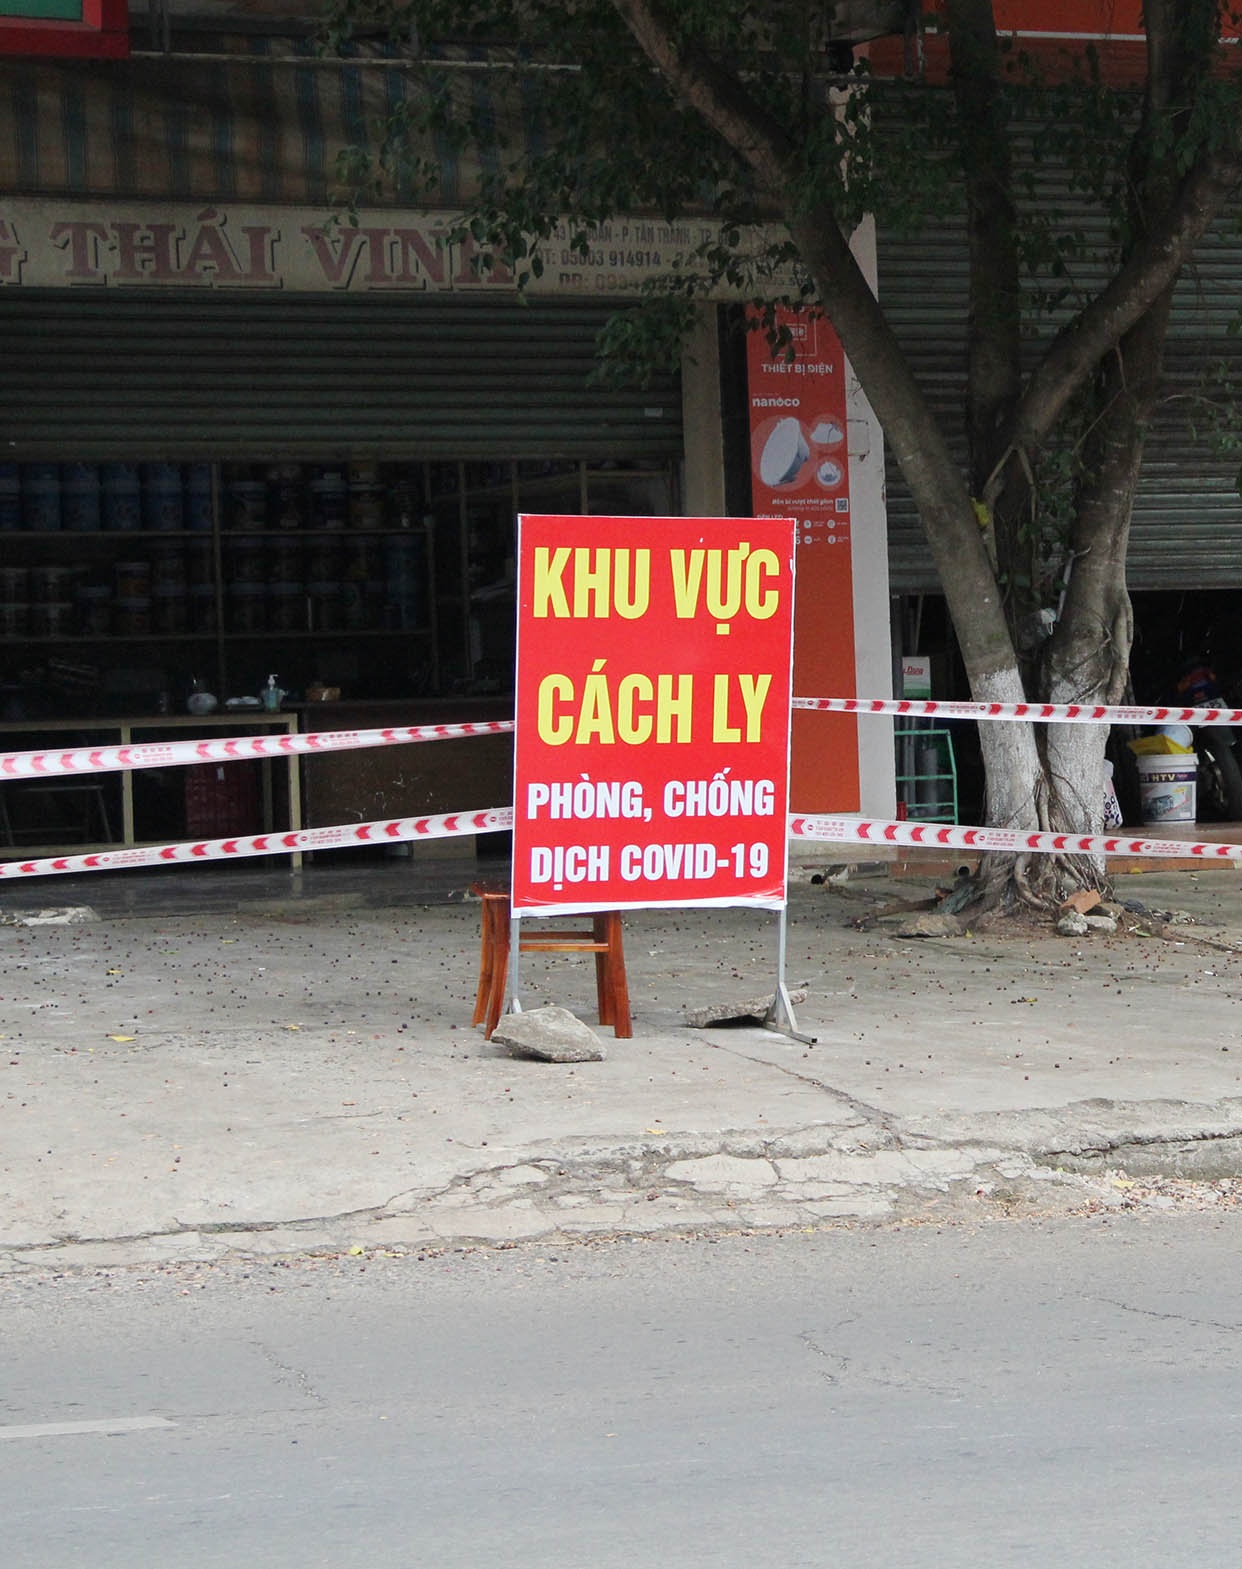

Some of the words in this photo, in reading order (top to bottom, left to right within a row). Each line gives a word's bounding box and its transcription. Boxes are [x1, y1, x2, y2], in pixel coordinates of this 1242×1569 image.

[49, 207, 281, 286] THÁI
[609, 250, 661, 267] 914914
[752, 396, 801, 408] nanoco
[533, 546, 651, 620] KHU
[669, 542, 780, 635] VỰC
[537, 659, 694, 746] CÁCH
[712, 674, 773, 744] LY
[527, 772, 653, 823] PHÒNG,
[663, 767, 776, 819] CHỐNG
[1151, 773, 1176, 782] HTV
[530, 845, 610, 891] DỊCH
[619, 842, 770, 882] COVID-19
